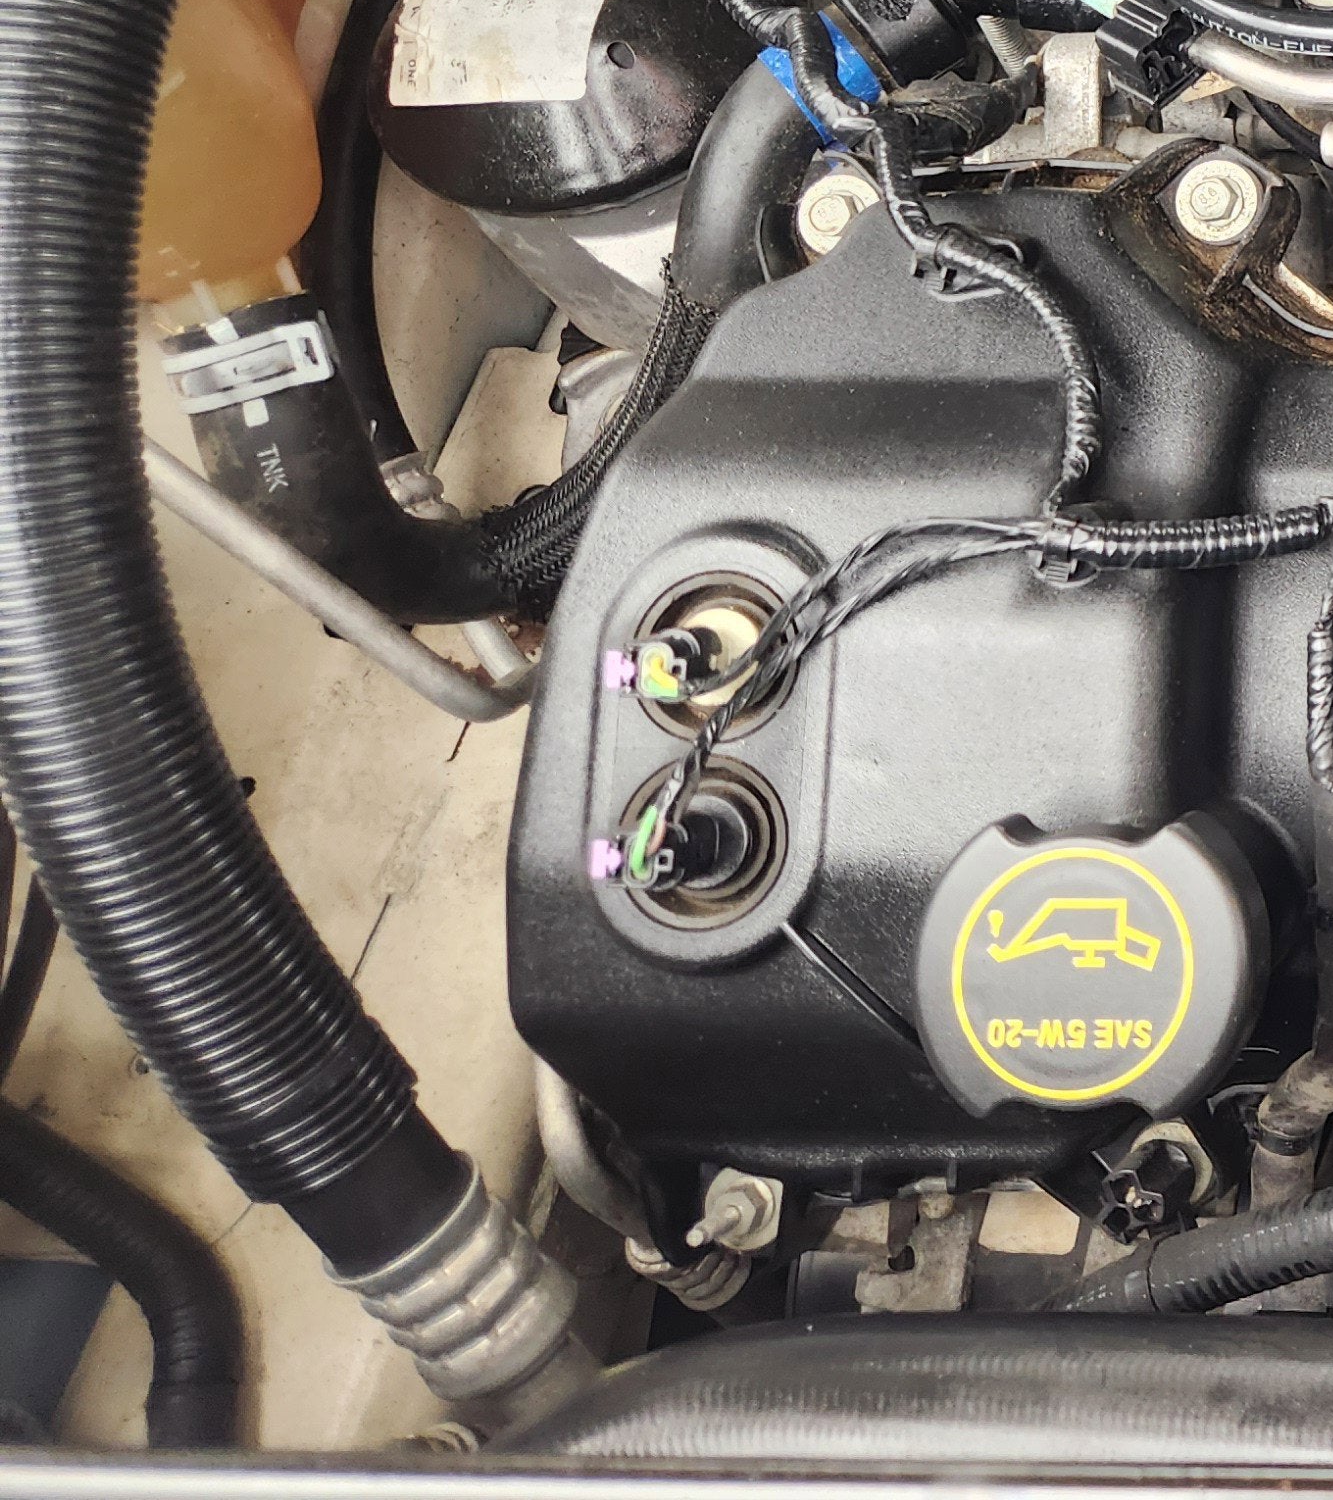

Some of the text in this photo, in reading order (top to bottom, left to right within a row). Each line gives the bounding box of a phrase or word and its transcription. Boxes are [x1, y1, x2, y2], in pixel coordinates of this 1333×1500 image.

[256, 442, 289, 491] TNK
[988, 1017, 1152, 1049] SAE 5W-20
